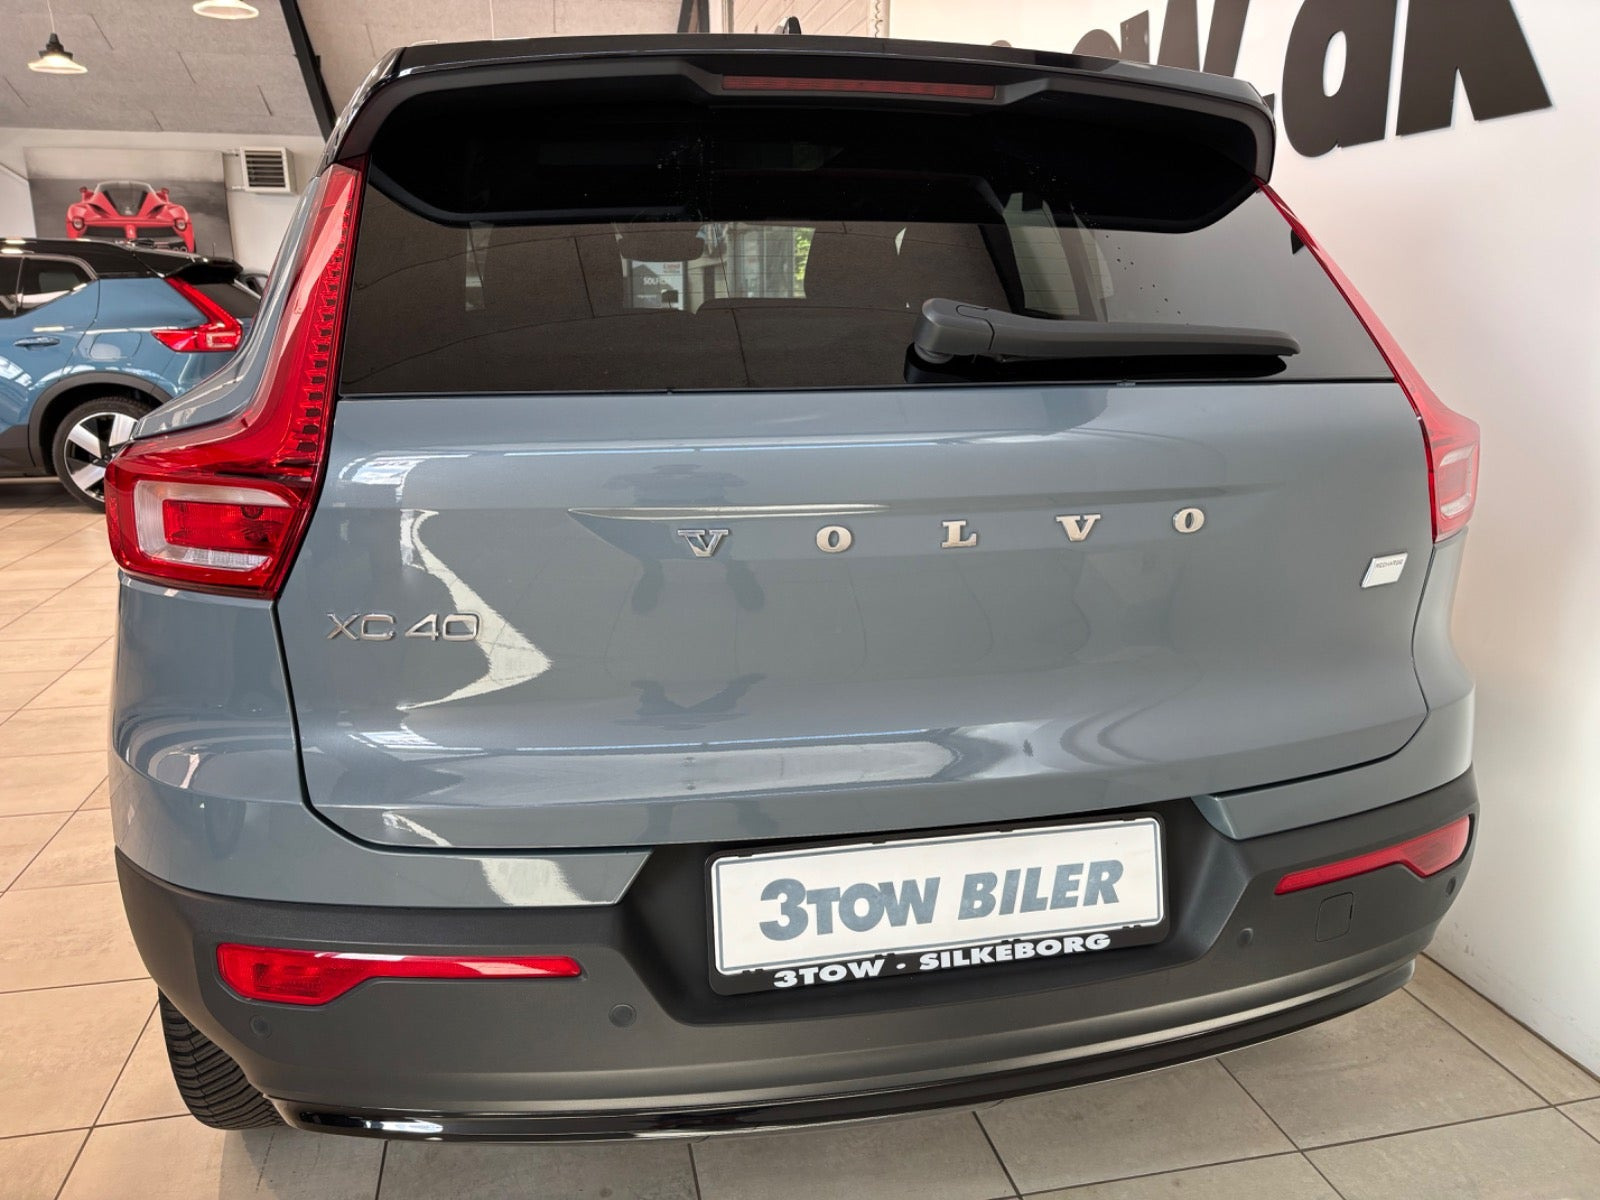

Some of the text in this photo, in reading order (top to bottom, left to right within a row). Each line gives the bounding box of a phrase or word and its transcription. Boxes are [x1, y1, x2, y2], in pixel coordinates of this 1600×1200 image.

[677, 507, 1206, 558] VOLVO
[759, 859, 1124, 941] 3TOW BILER
[773, 933, 1111, 988] 3TOW SILKEBORG
